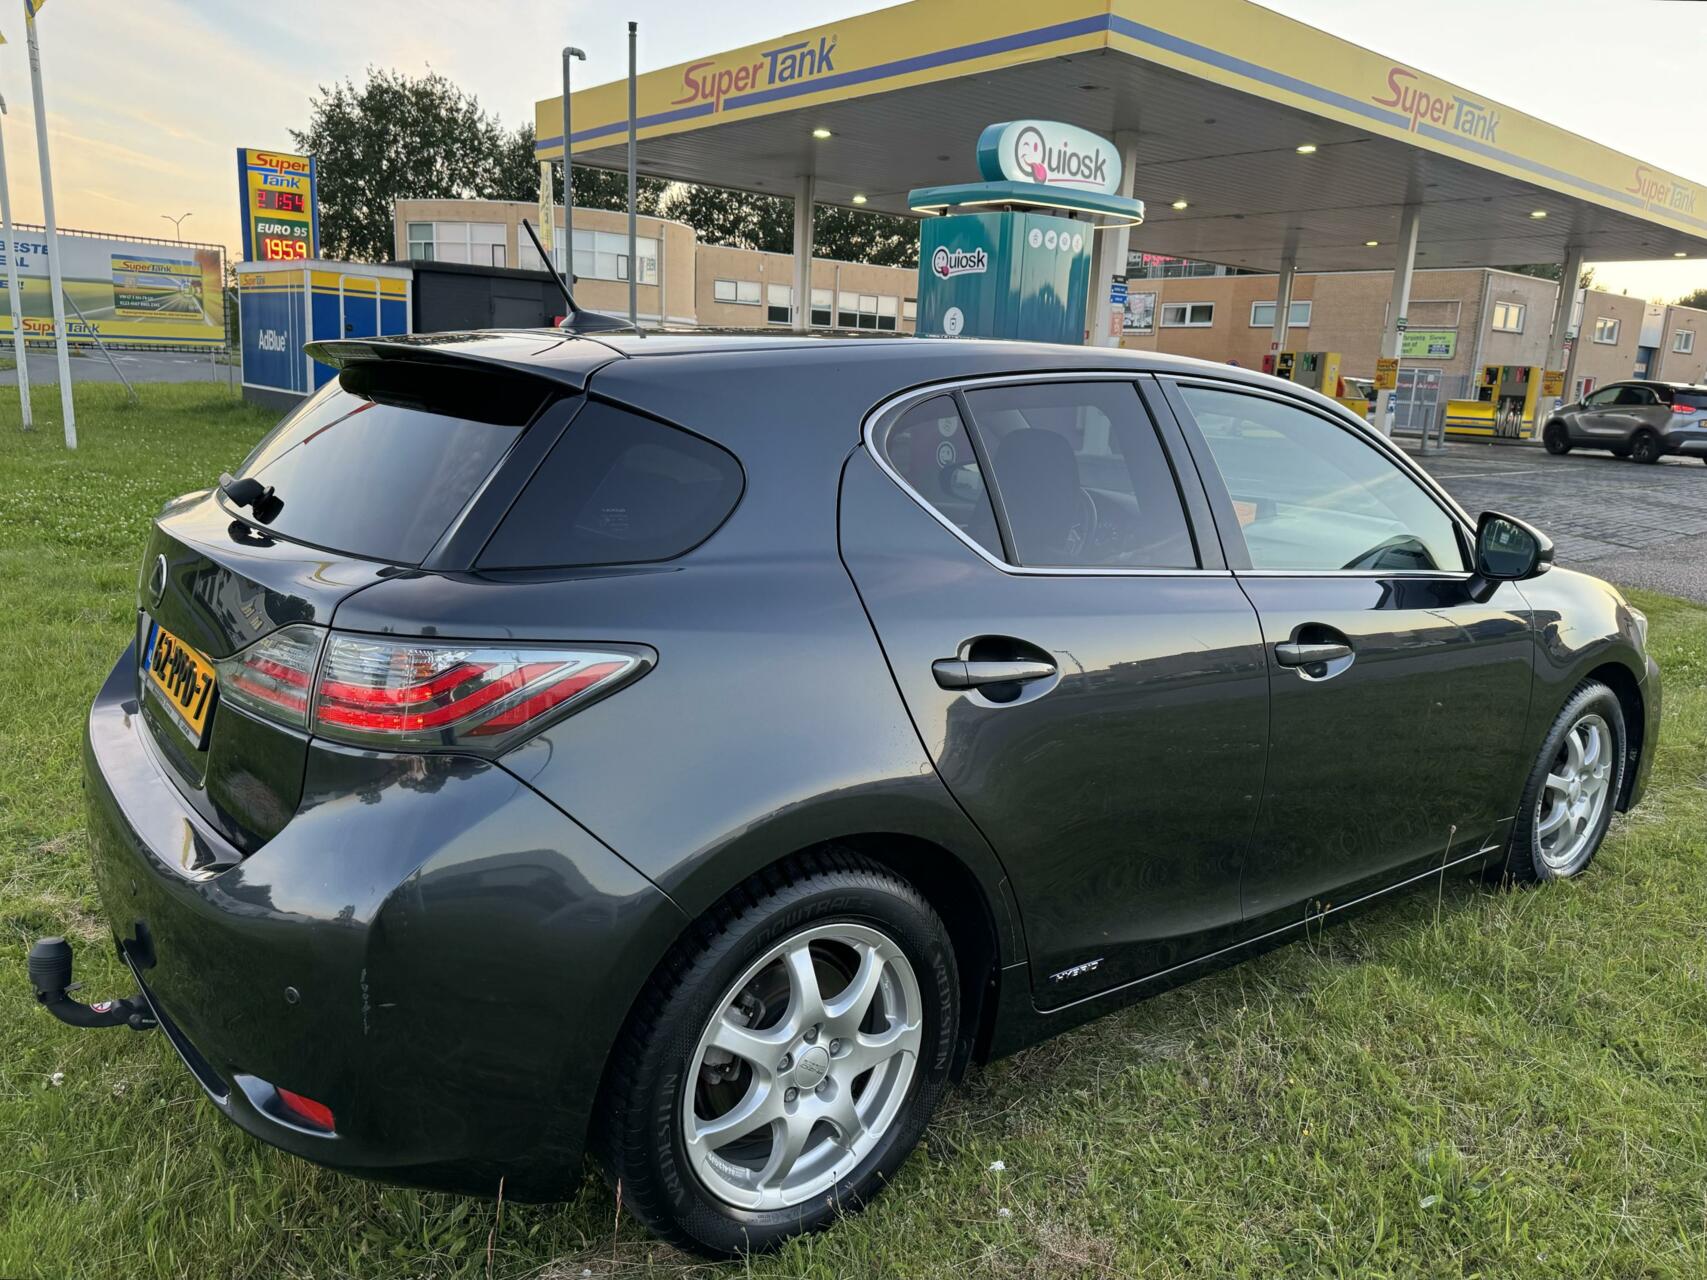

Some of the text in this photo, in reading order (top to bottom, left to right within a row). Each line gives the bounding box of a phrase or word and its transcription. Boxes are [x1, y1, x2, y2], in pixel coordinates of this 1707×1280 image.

[247, 153, 308, 174] Super
[1014, 126, 1106, 184] Quiosk
[258, 173, 300, 189] Tank
[257, 223, 308, 237] EURO 95
[934, 248, 986, 276] Quiosk
